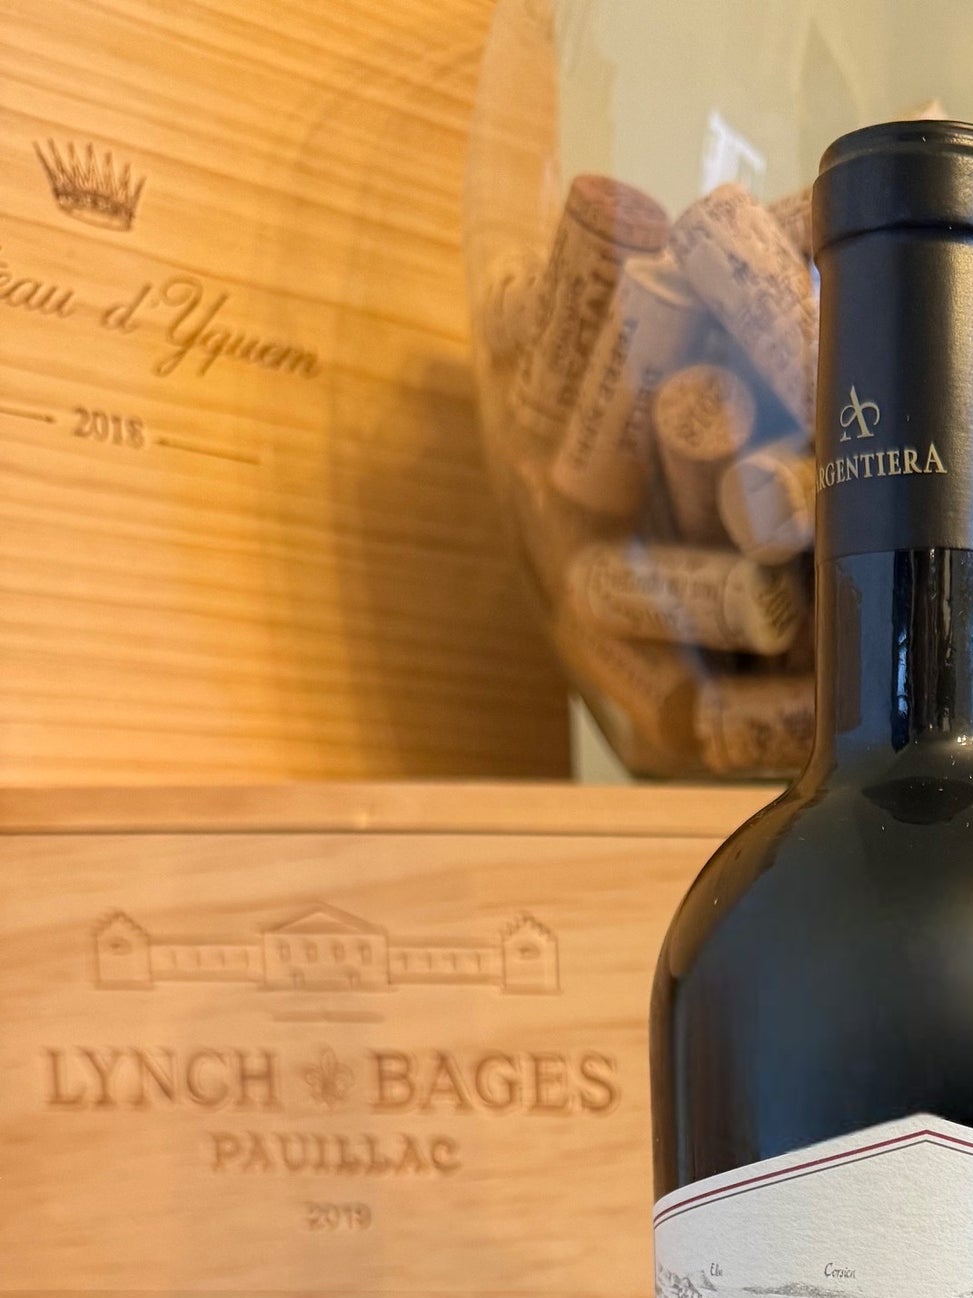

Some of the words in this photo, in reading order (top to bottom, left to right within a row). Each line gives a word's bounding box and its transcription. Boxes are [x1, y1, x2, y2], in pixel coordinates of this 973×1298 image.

[72, 406, 145, 450] 2018
[46, 1046, 282, 1111] LYNCH
[370, 1050, 621, 1114] BAGES
[211, 1131, 461, 1173] PAUILLAC
